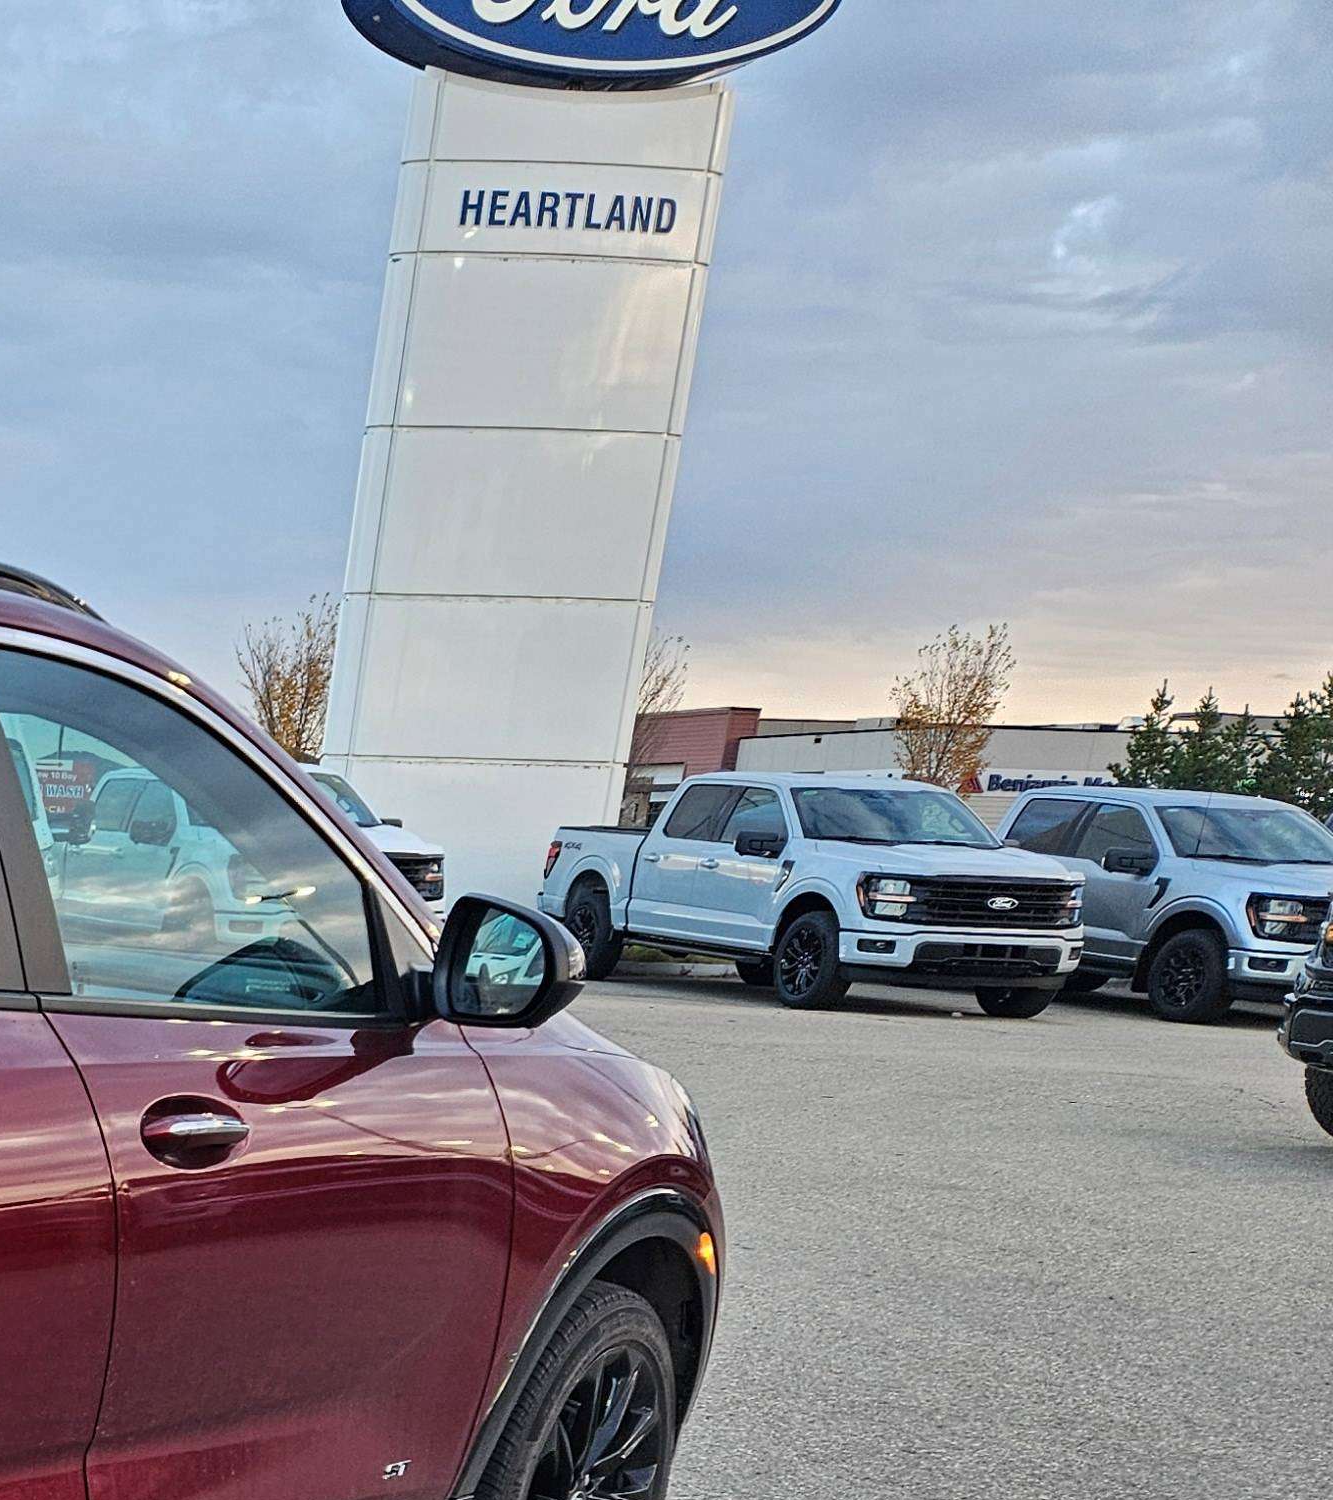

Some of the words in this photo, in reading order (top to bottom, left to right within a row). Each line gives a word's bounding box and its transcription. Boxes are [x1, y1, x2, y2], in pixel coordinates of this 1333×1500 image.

[459, 189, 678, 235] HEARTLAND
[46, 783, 84, 798] WASH
[382, 1459, 412, 1480] ST
